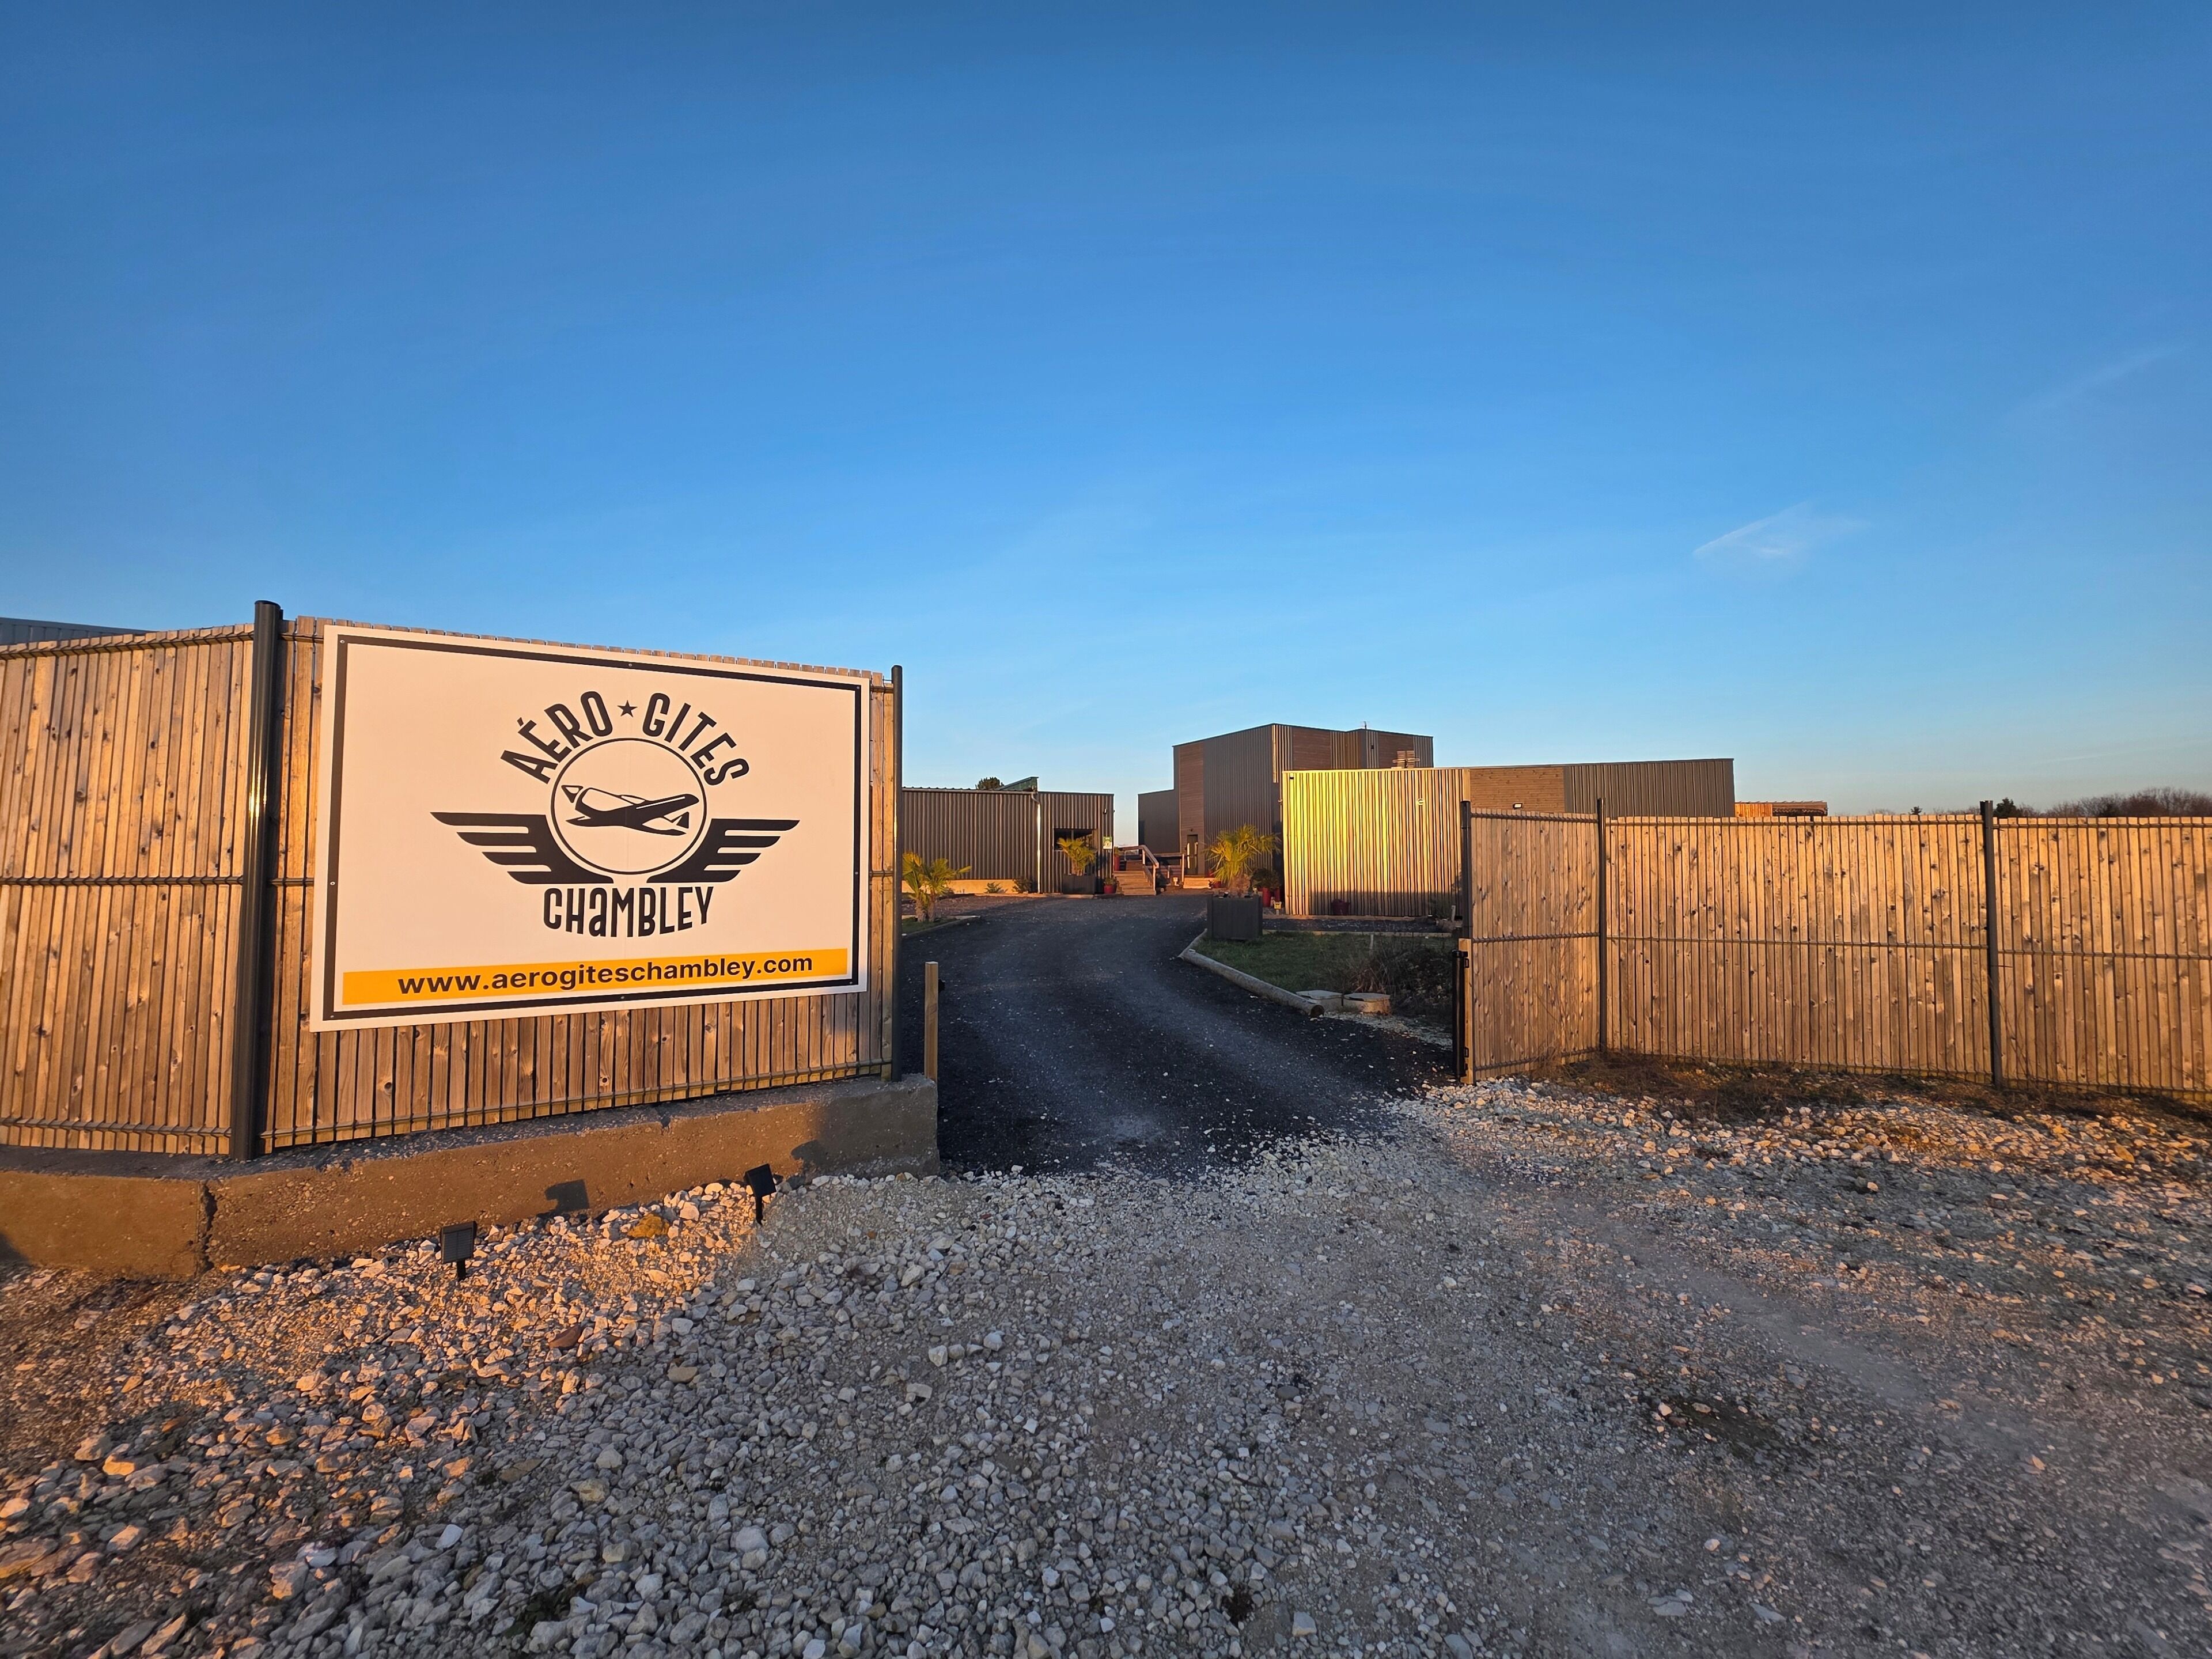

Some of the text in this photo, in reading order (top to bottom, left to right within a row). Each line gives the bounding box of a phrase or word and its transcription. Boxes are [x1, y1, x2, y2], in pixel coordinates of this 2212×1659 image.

[500, 691, 749, 786] AÉRO GITES
[398, 957, 812, 994] www.aerogiteschambley.com
